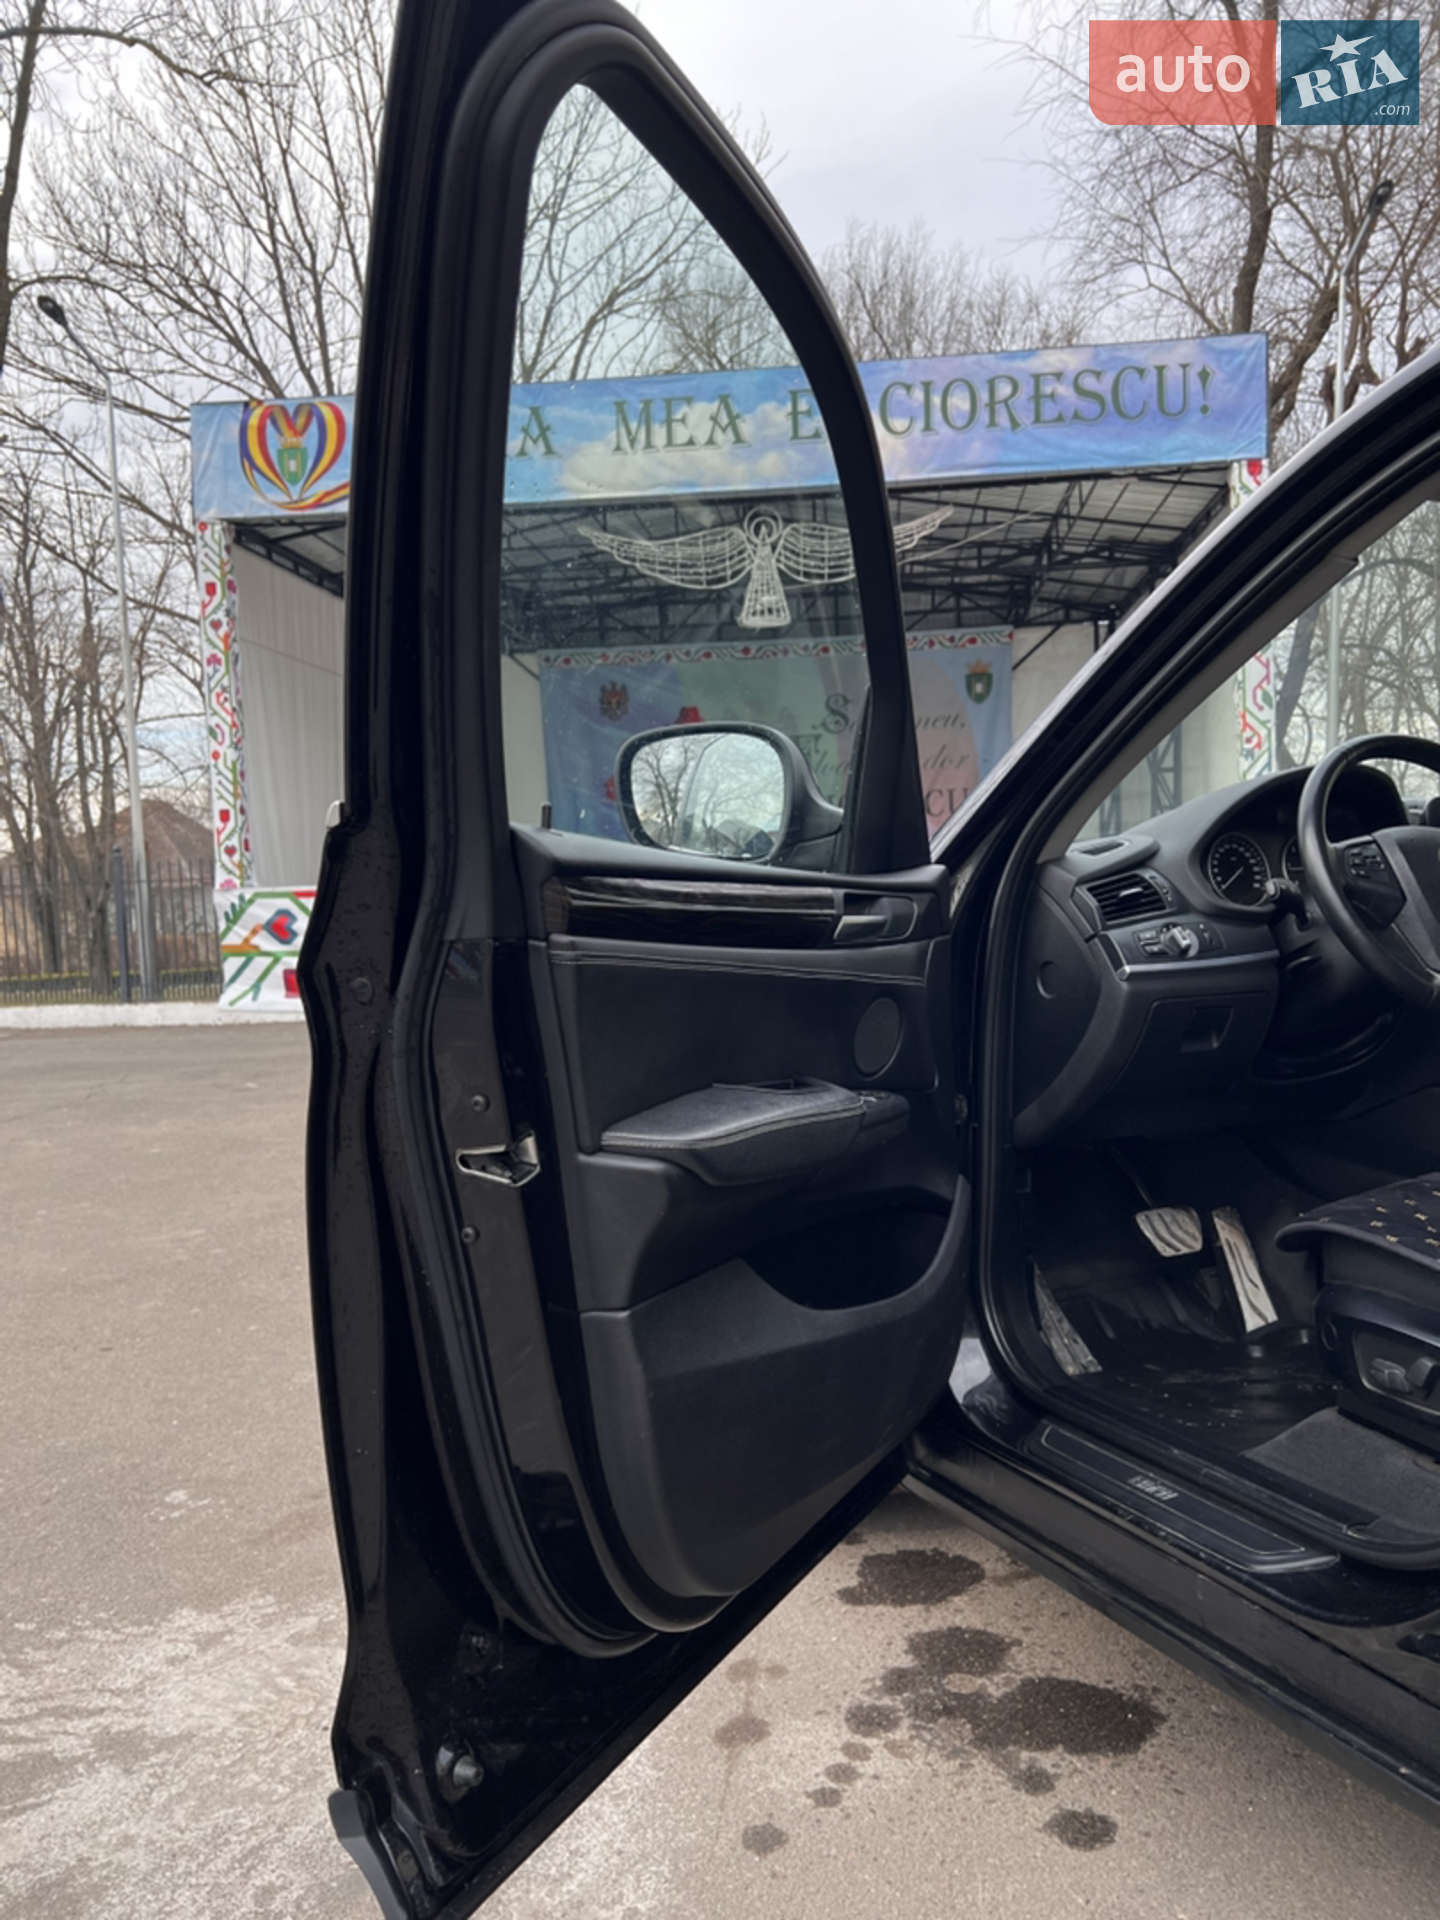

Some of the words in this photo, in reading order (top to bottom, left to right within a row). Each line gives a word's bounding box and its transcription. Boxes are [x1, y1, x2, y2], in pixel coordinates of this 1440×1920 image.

[515, 405, 558, 457] A
[611, 393, 749, 456] MEA
[878, 362, 1215, 437] CIORESCU!
